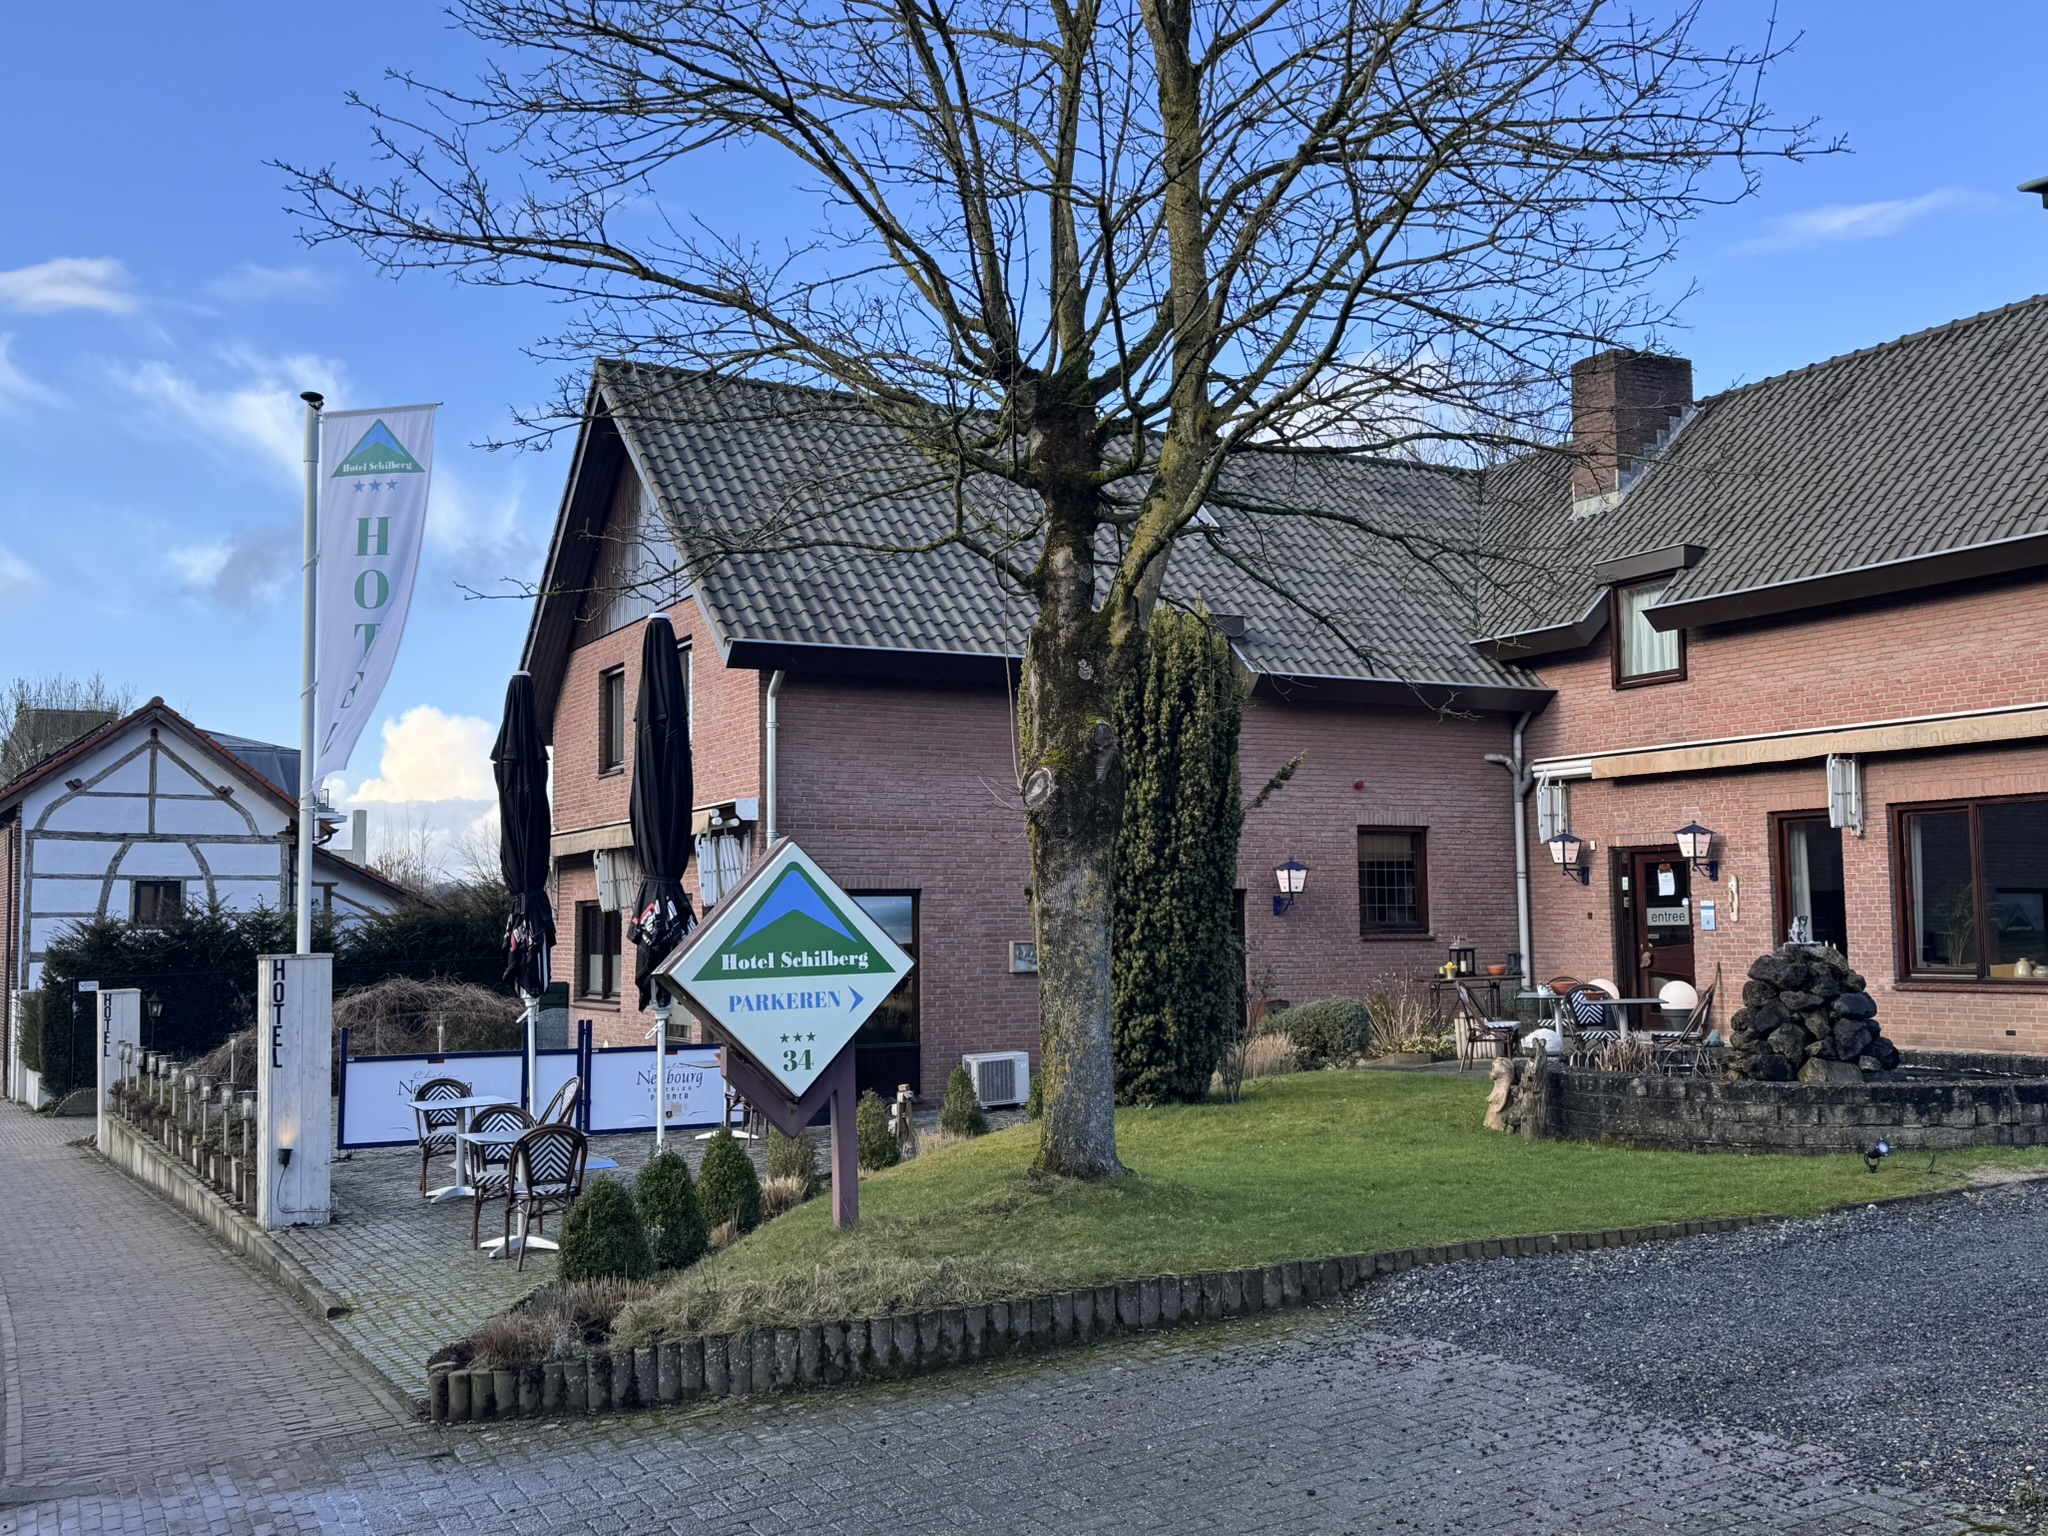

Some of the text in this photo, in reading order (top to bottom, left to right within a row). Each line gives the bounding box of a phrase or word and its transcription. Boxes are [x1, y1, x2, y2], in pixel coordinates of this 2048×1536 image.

[343, 460, 412, 473] Hotel Schilberg
[1651, 911, 1686, 923] entree
[720, 950, 869, 971] Hotel Schilberg
[729, 990, 841, 1013] PARKEREN
[272, 959, 286, 1068] HOTEL
[103, 994, 112, 1057] HOTEL
[783, 1049, 814, 1072] 34
[636, 1069, 703, 1088] Nebourg
[650, 1093, 689, 1101] PSNER
